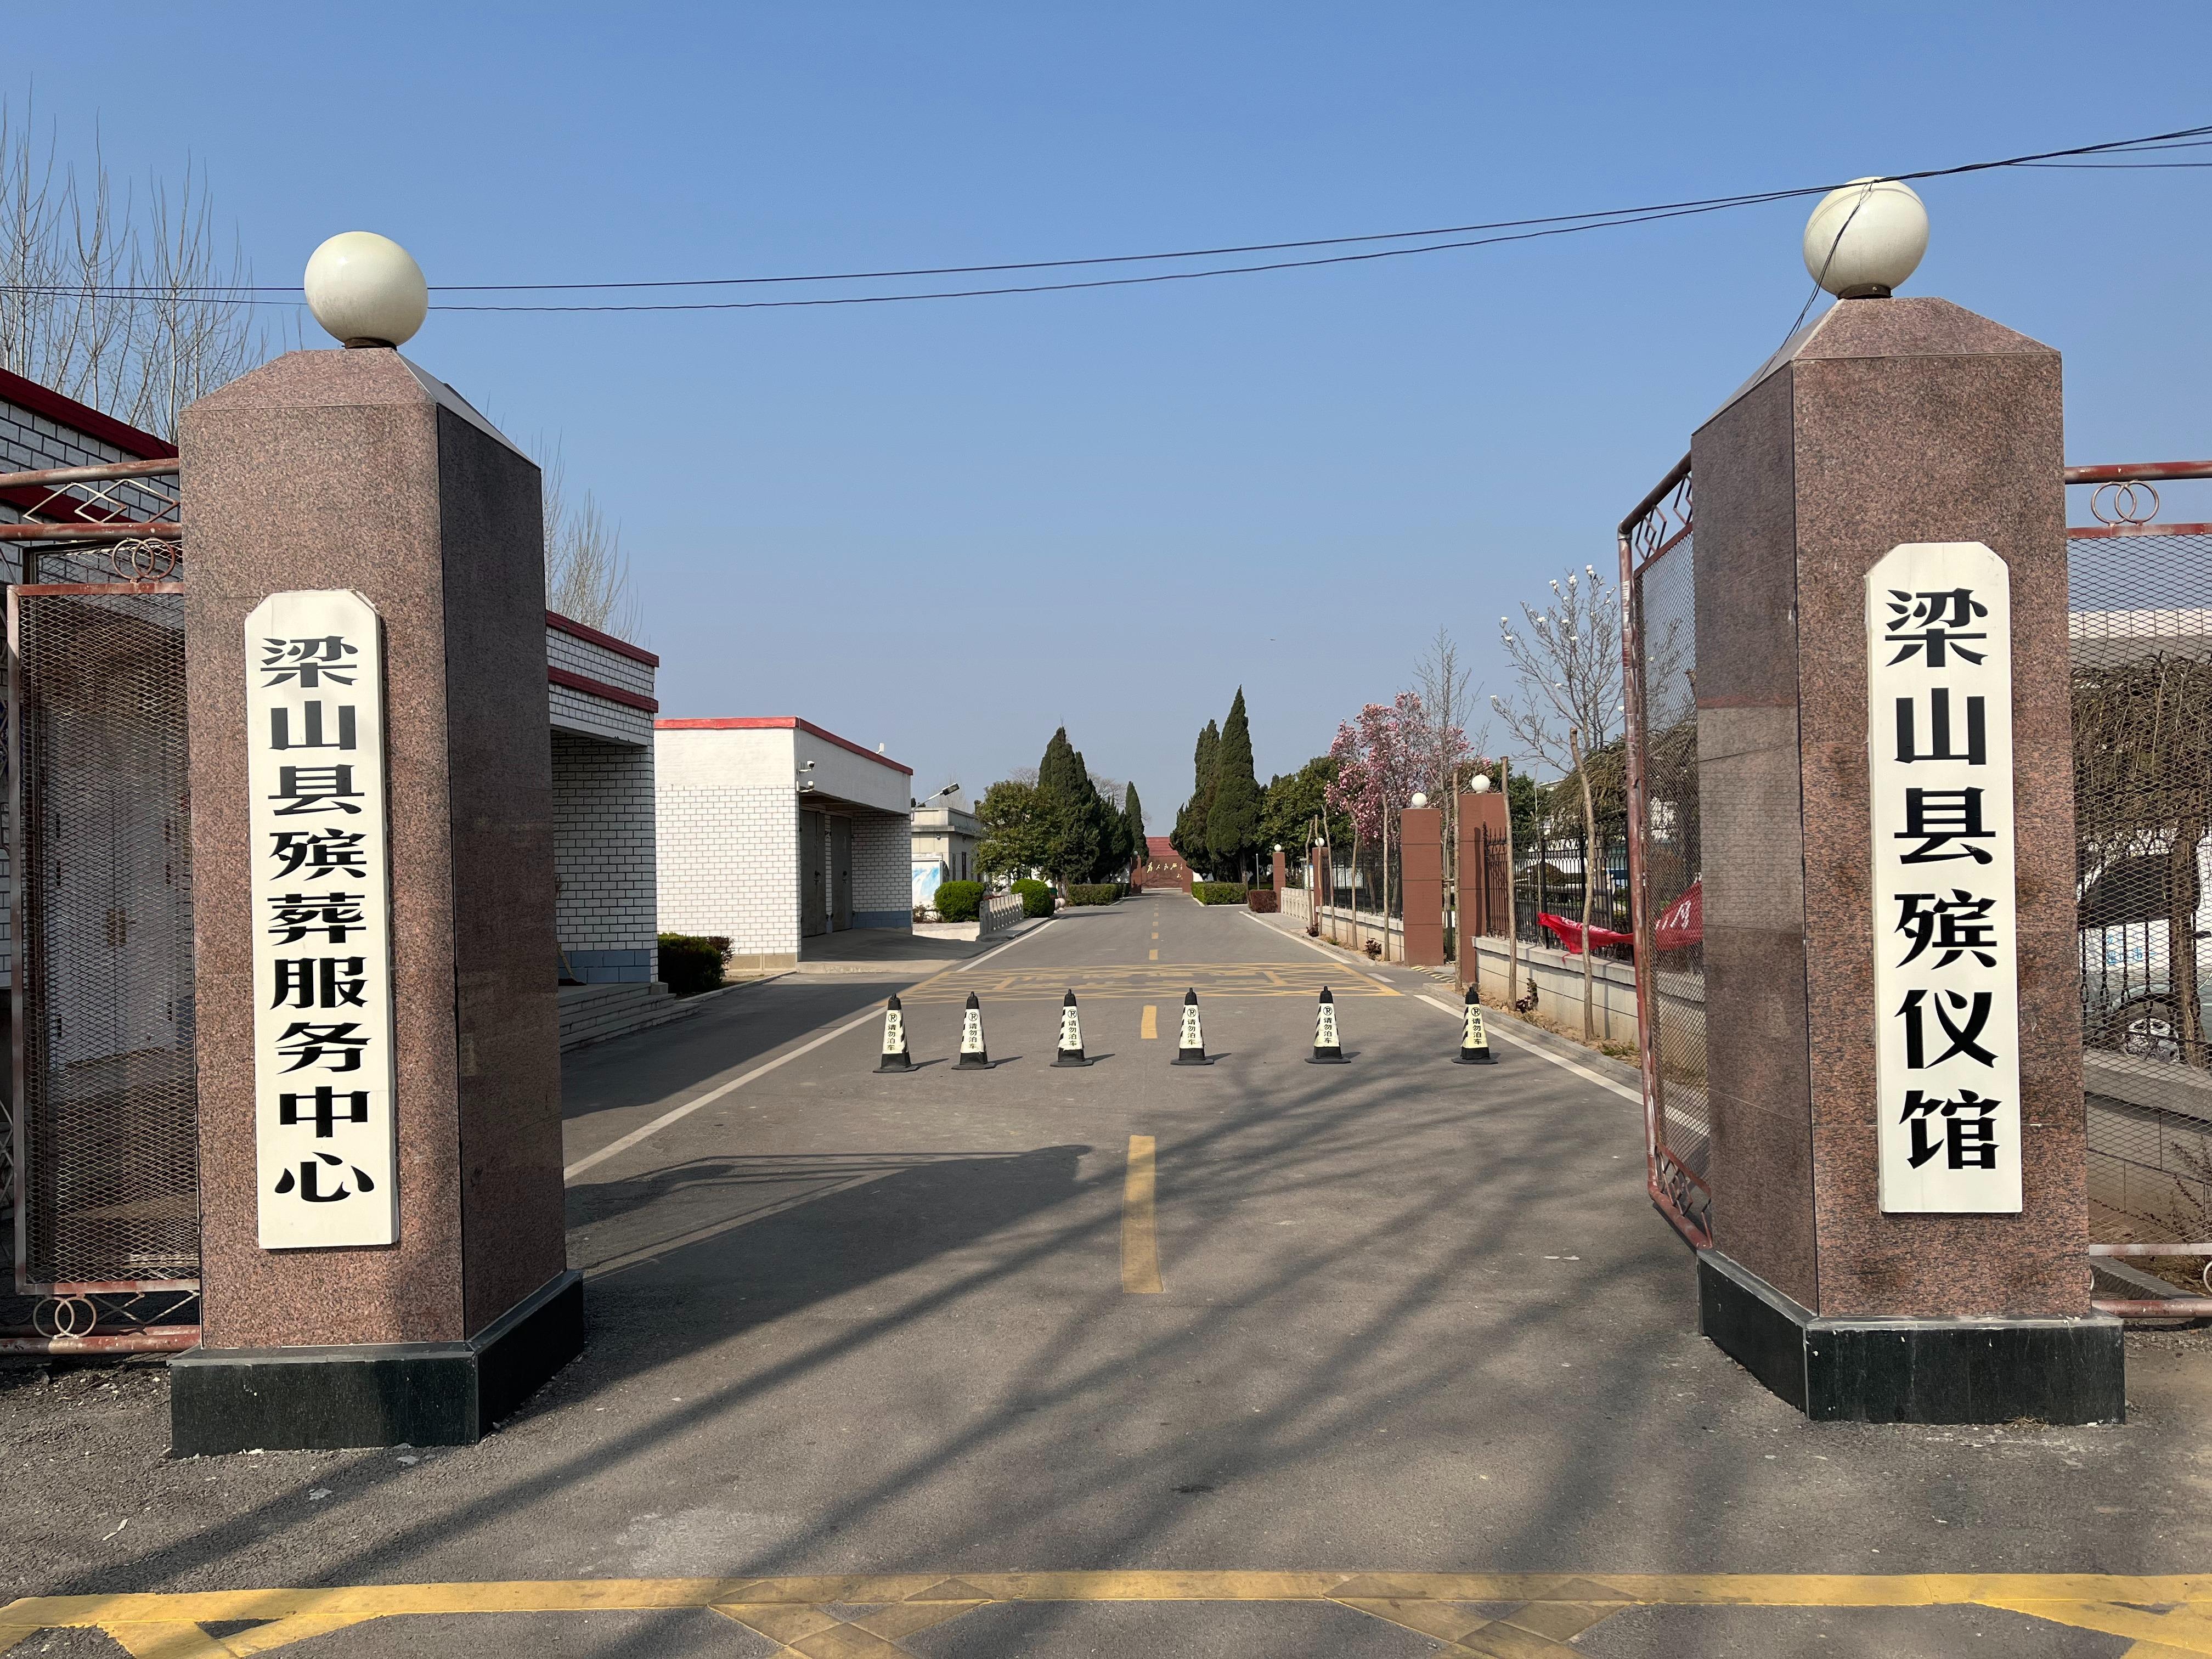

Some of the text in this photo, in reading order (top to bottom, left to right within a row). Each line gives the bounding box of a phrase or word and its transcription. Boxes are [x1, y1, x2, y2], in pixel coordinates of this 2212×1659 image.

[1884, 588, 2000, 1170] 梁山县殡仪馆
[260, 635, 375, 1203] 梁山县殡葬服务中心
[887, 1024, 897, 1051] 请勿泊车
[968, 1023, 978, 1049] 请勿泊车
[1068, 1020, 1077, 1046] 请勿泊车
[1187, 1019, 1196, 1045] 请勿泊车
[1323, 1017, 1333, 1043] 请勿泊车
[1471, 1018, 1482, 1045] 请勿泊车
